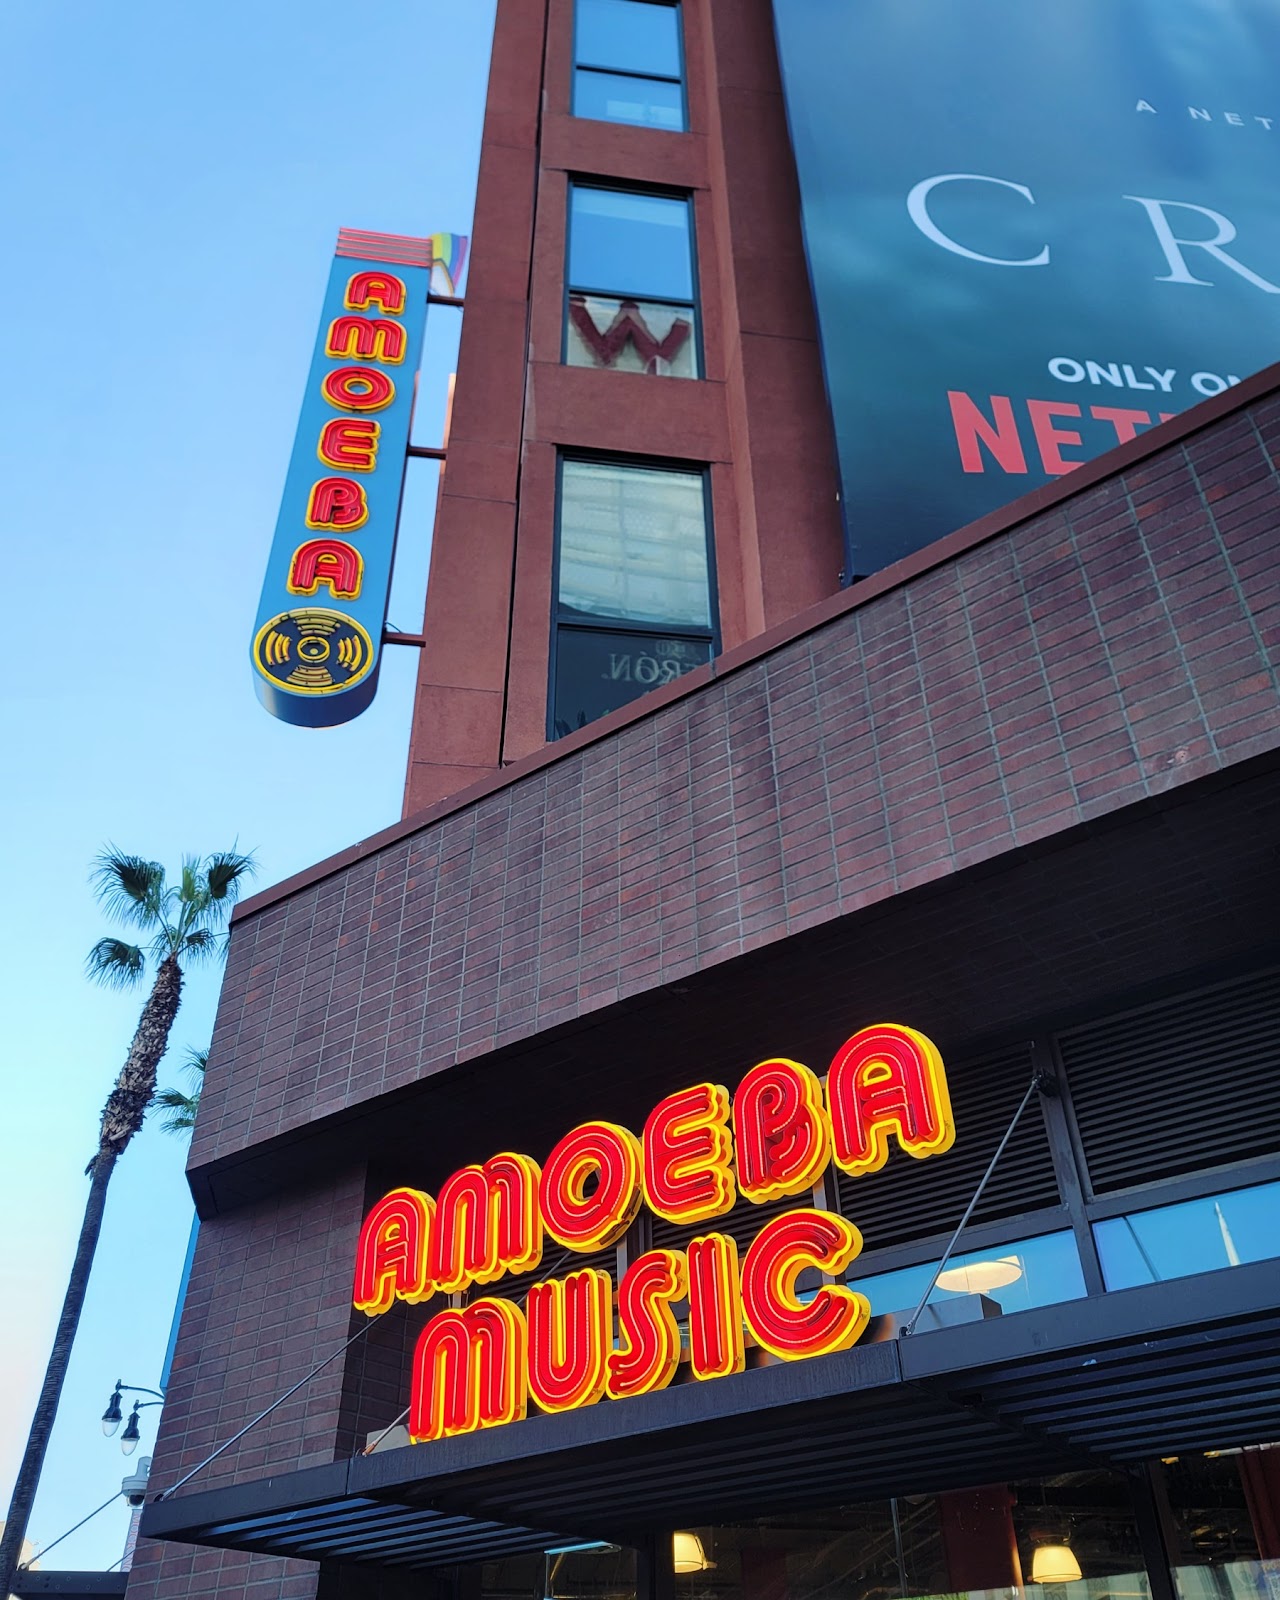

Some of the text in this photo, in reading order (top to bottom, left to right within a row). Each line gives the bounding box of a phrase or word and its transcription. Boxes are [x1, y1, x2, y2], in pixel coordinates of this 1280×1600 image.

[1136, 99, 1273, 130] A NET
[906, 173, 1280, 294] CR
[947, 390, 1177, 476] NET
[1047, 356, 1176, 393] ONLY
[286, 271, 407, 601] AMOEBA
[354, 1023, 957, 1317] AMOEBA
[410, 1209, 872, 1444] MUSIC
